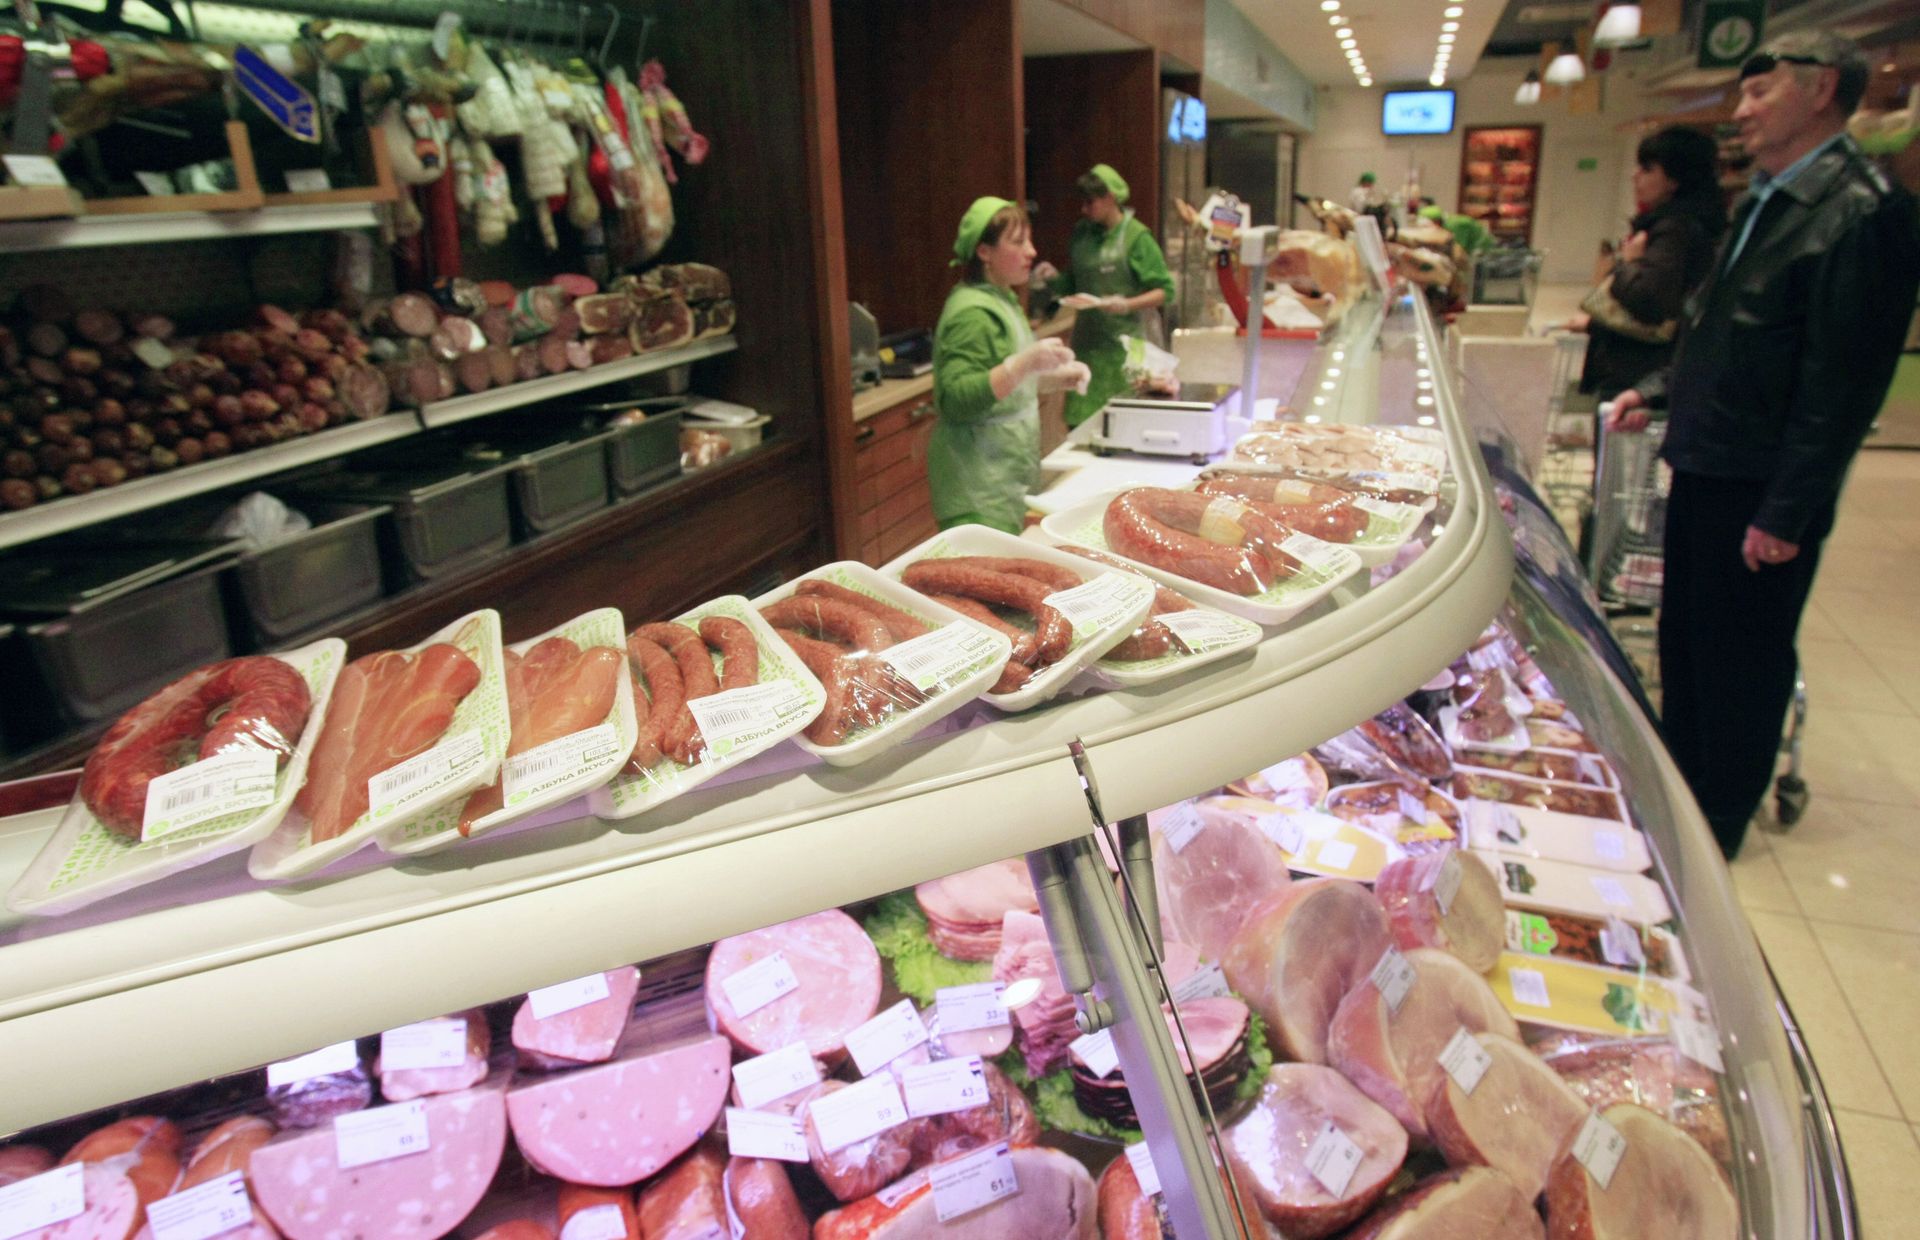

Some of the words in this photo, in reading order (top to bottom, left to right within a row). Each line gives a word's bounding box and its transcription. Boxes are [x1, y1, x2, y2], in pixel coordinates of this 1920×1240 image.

[967, 644, 998, 661] ВКУСА
[734, 726, 776, 746] АЗБУКА
[776, 710, 810, 729] ВКУСА
[396, 779, 441, 806] АЗБУКА
[443, 759, 480, 782] ВКУСА
[530, 772, 576, 795] АЗБУКА
[576, 757, 615, 776] ВКУСА
[991, 1178, 1004, 1192] 61
